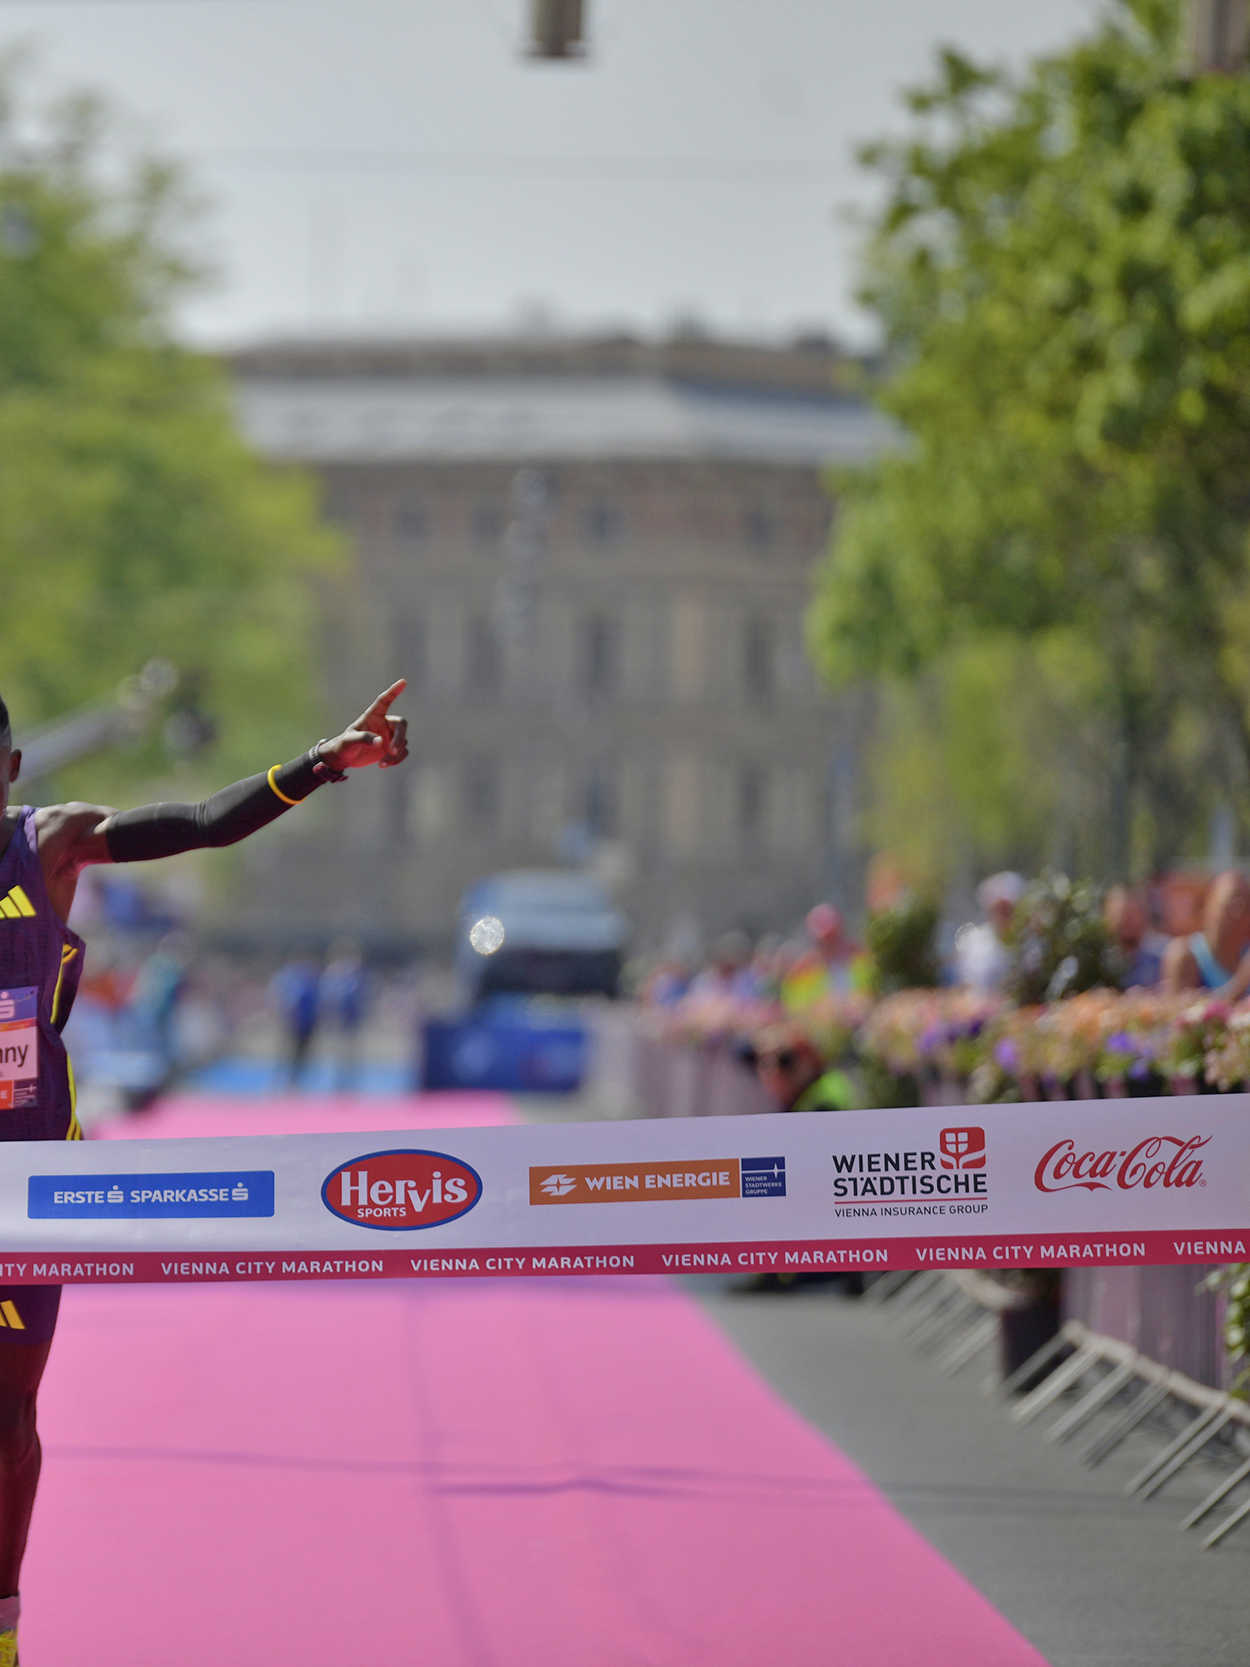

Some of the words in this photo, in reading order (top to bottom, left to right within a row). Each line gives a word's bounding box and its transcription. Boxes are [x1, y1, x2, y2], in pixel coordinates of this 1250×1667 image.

[832, 1151, 936, 1173] WIENER
[1034, 1134, 1213, 1193] Coca-Cola
[584, 1174, 639, 1191] WIEN
[645, 1171, 730, 1188] ENERGIE
[833, 1173, 988, 1197] STÄDTISCHE
[53, 1190, 105, 1204] ERSTE
[130, 1188, 229, 1203] SPARKASSE
[340, 1170, 468, 1213] Hervis
[357, 1206, 407, 1218] SPORTS
[835, 1208, 878, 1218] VIENNA
[880, 1206, 946, 1217] INSURANCE
[949, 1204, 989, 1214] GROUP
[915, 1246, 987, 1262] VIENNA
[992, 1245, 1034, 1260] CITY
[1040, 1242, 1146, 1259] MARATHON
[1173, 1240, 1247, 1256] VIENNA
[410, 1258, 480, 1272] VIENNA
[485, 1257, 526, 1270] CITY
[532, 1255, 635, 1270] MARATHON
[661, 1252, 732, 1267] VIENNA
[737, 1251, 779, 1266] CITY
[784, 1248, 888, 1265] MARATHON
[32, 1262, 134, 1277] MARATHON
[160, 1261, 230, 1276] VIENNA
[235, 1261, 276, 1275] CITY
[281, 1259, 384, 1274] MARATHON
